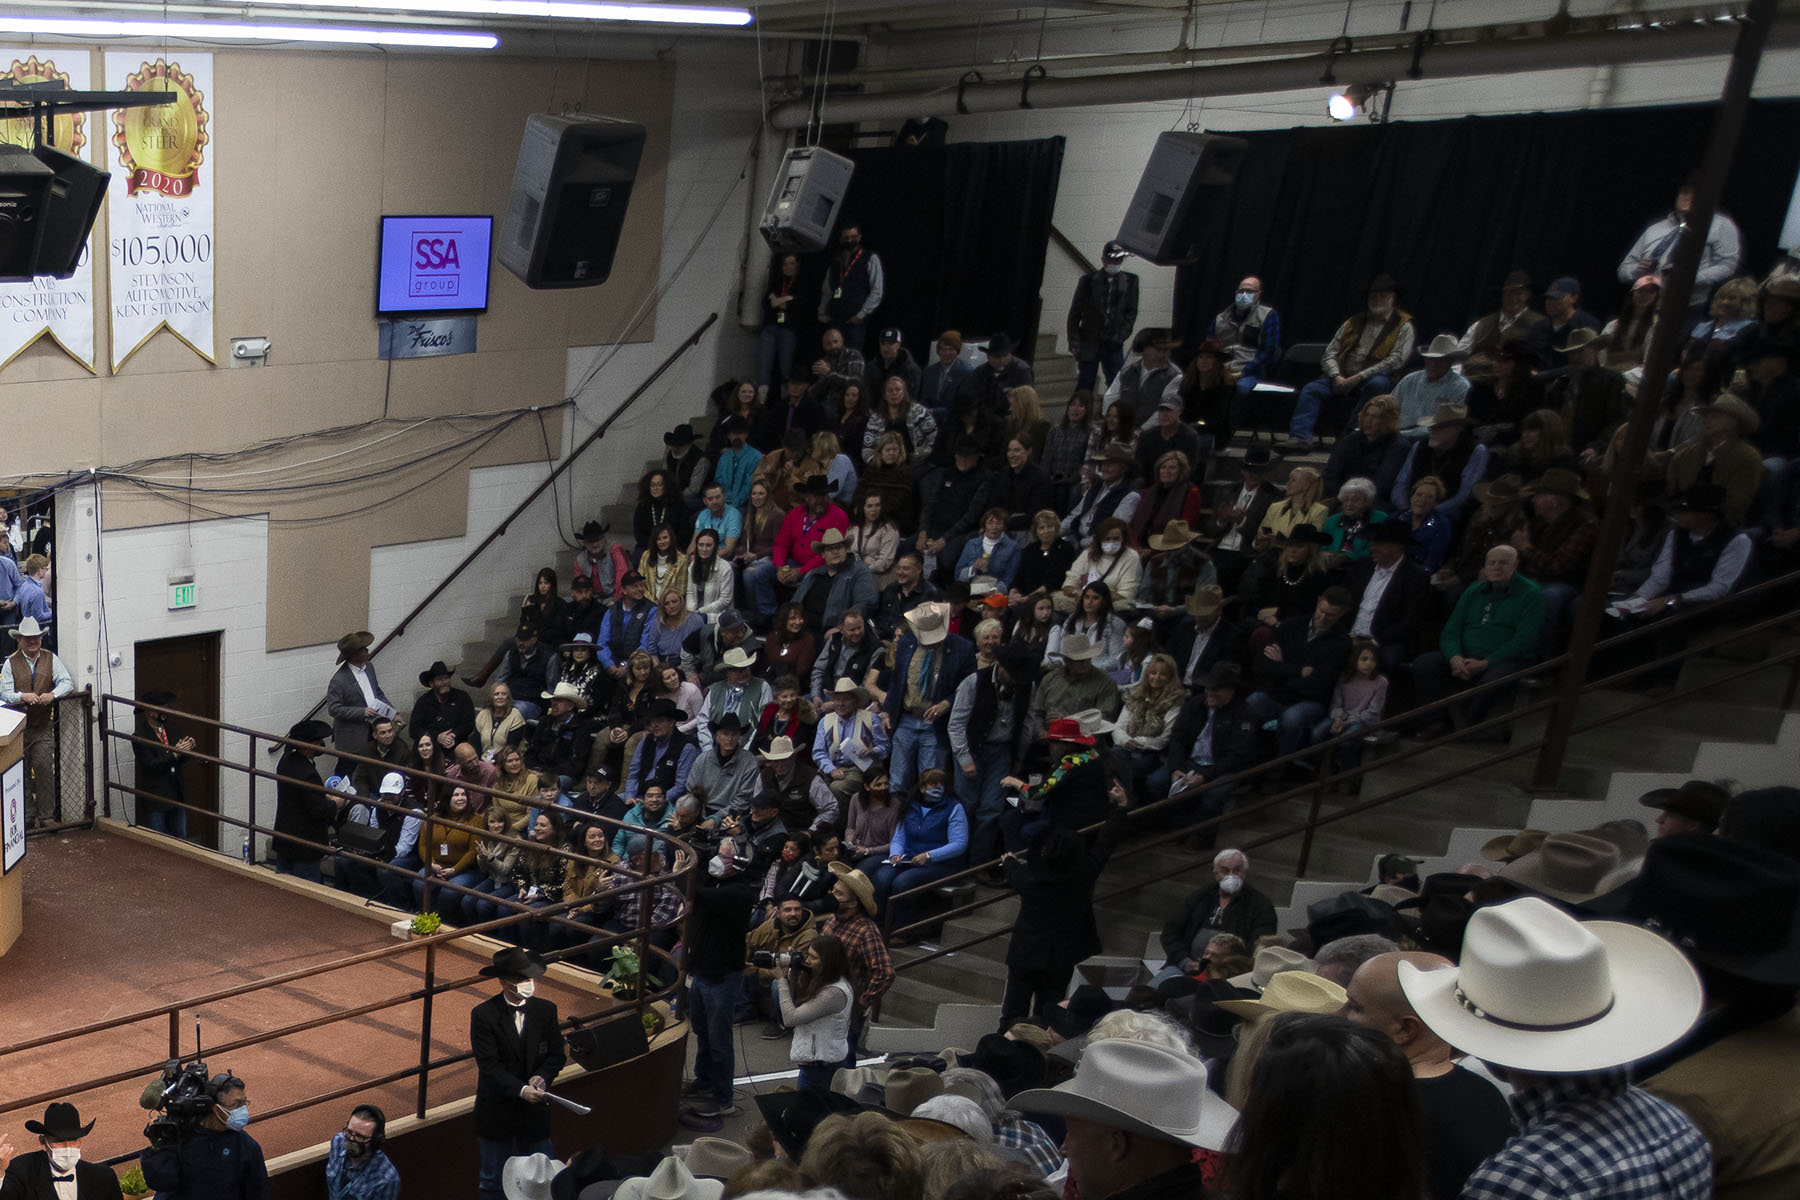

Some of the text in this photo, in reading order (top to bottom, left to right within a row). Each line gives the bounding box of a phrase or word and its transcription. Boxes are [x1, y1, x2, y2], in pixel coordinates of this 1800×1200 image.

[141, 135, 179, 150] STEER
[140, 170, 183, 195] 2020
[135, 203, 177, 215] NATIONAL
[140, 213, 182, 224] WESTERN
[111, 234, 211, 269] $105,000
[414, 238, 461, 270] SSA
[415, 279, 455, 293] group
[12, 308, 70, 323] COMPANY
[116, 304, 147, 318] KENT
[410, 330, 453, 349] Frisco's
[175, 584, 195, 606] EXIT
